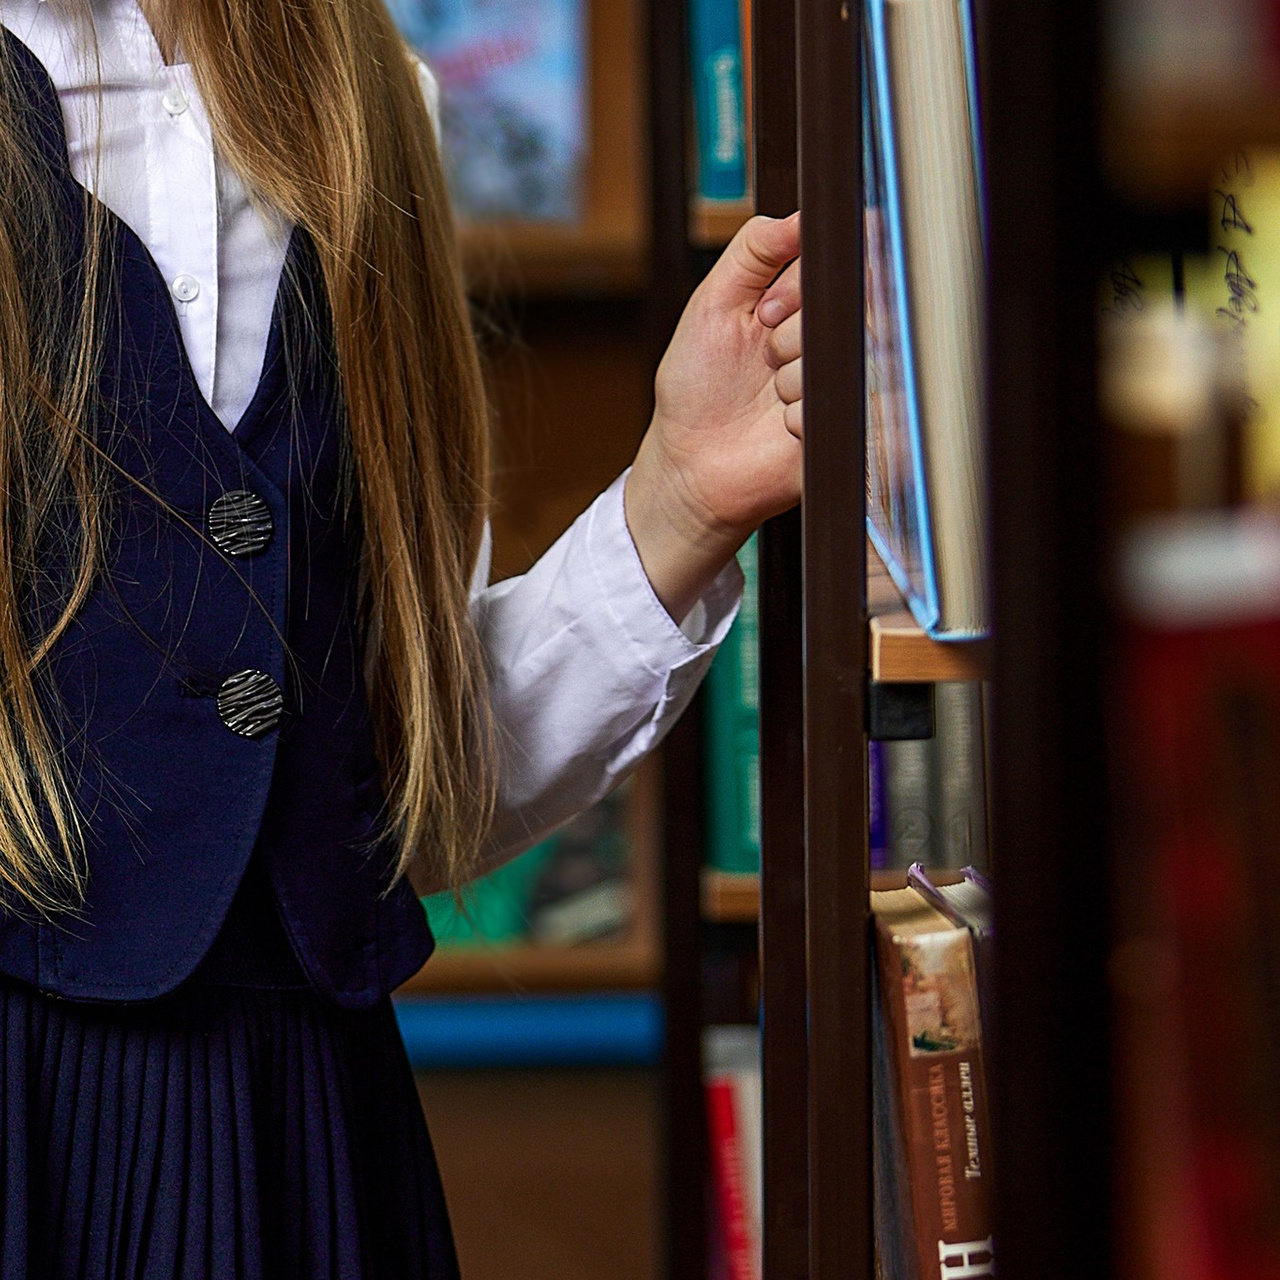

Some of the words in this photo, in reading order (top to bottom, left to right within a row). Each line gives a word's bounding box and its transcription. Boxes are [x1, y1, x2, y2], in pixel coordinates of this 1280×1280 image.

[927, 1063, 952, 1151] КЛАССИКА
[962, 1114, 982, 1180] Темные
[935, 1154, 959, 1232] МИРОВАЯ
